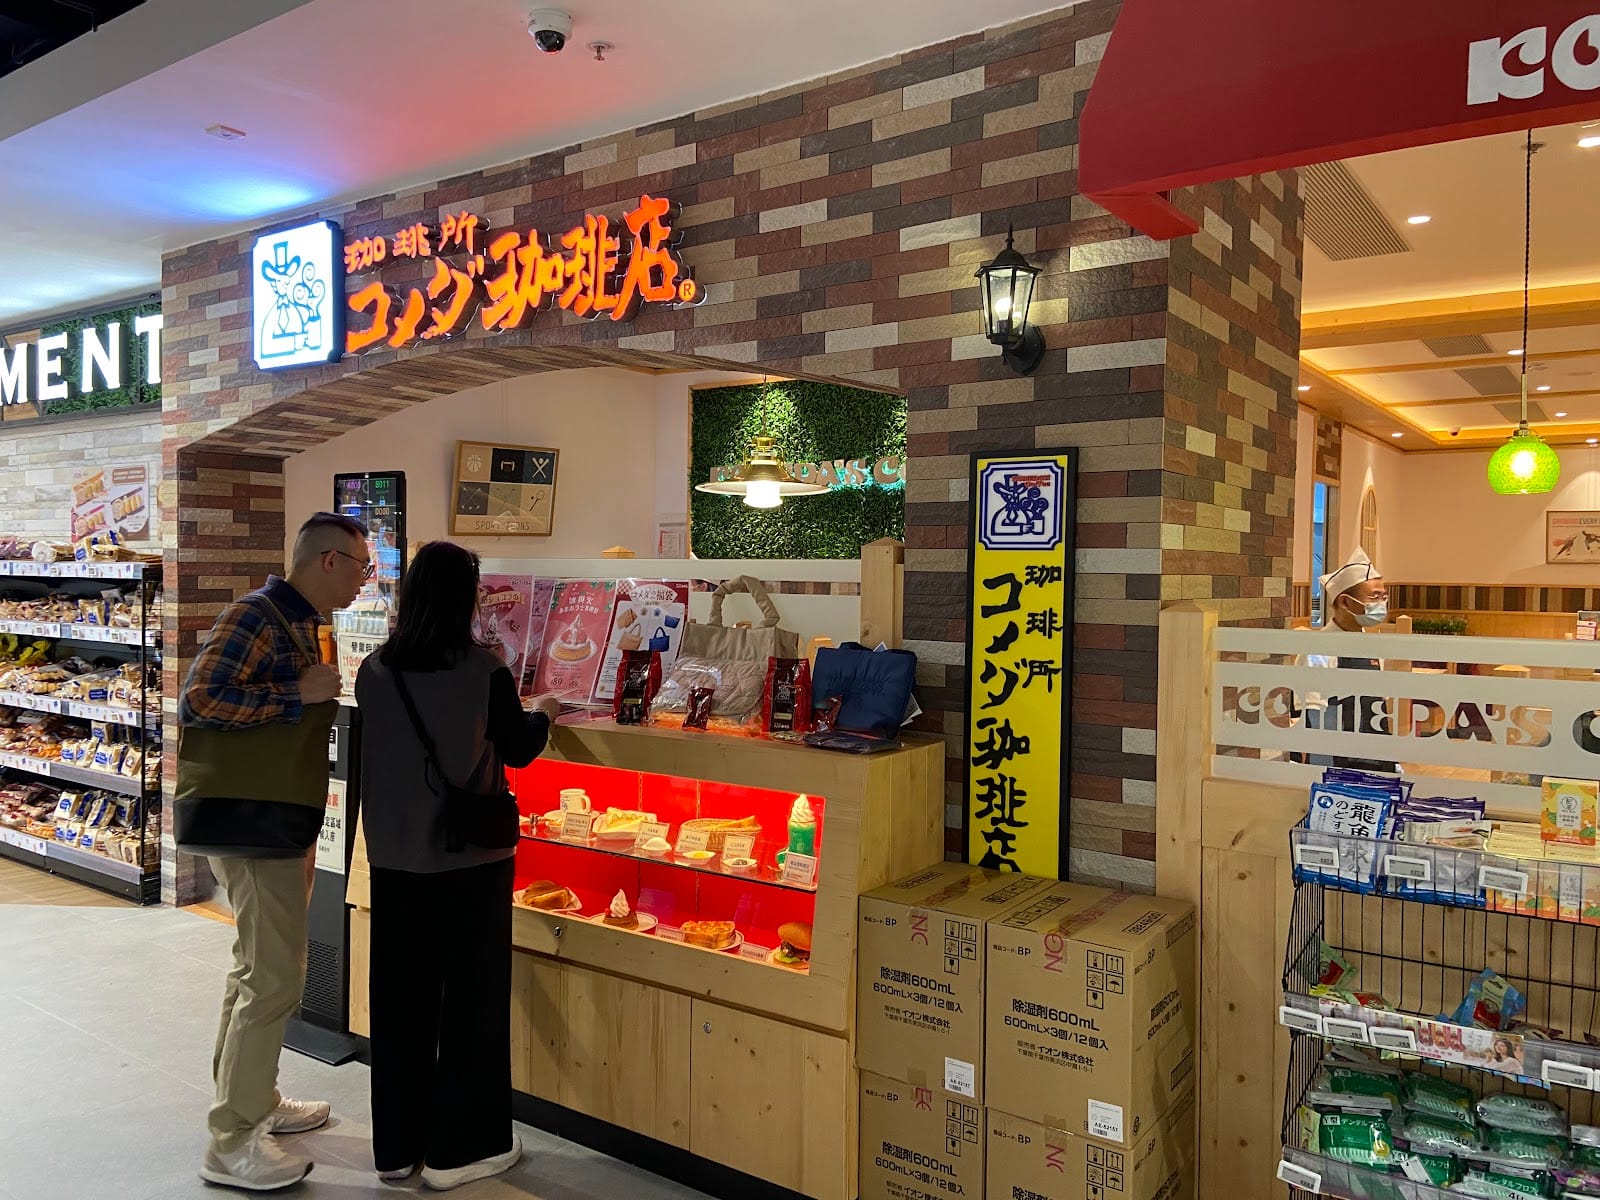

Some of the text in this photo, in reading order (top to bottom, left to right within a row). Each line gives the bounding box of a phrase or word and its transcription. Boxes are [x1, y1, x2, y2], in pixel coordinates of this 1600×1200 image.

[885, 917, 897, 926] BP
[1017, 946, 1031, 957] BP
[1011, 998, 1100, 1032] 除湿剤600mL
[887, 1092, 899, 1103] BP
[1018, 1133, 1031, 1144] BP
